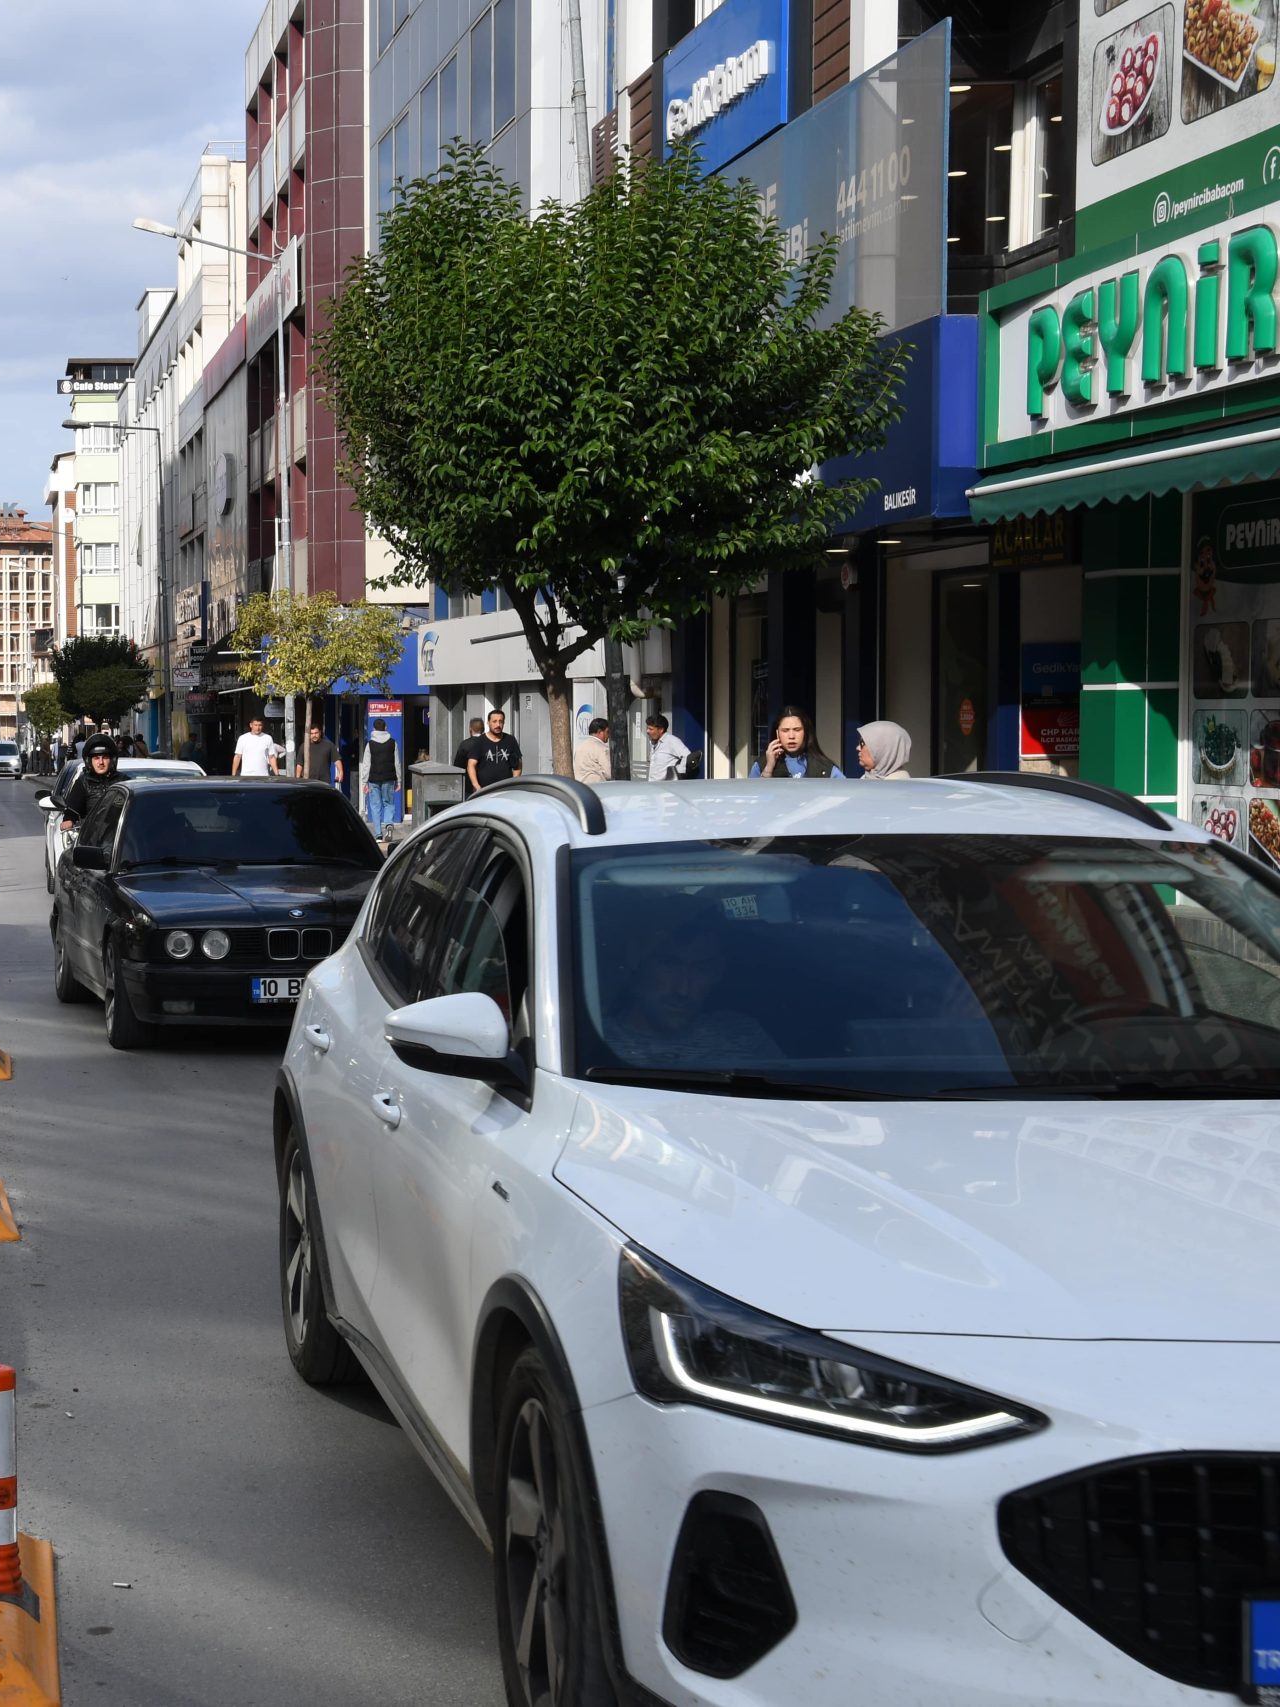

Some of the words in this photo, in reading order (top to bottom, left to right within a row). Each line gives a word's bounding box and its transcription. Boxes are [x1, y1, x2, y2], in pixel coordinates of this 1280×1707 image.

[836, 169, 868, 219] 444
[870, 157, 884, 201] 11
[888, 144, 911, 192] 00
[884, 485, 916, 511] BALIKESİR
[1040, 728, 1059, 736] CHP
[261, 979, 278, 997] 10
[288, 979, 305, 996] B
